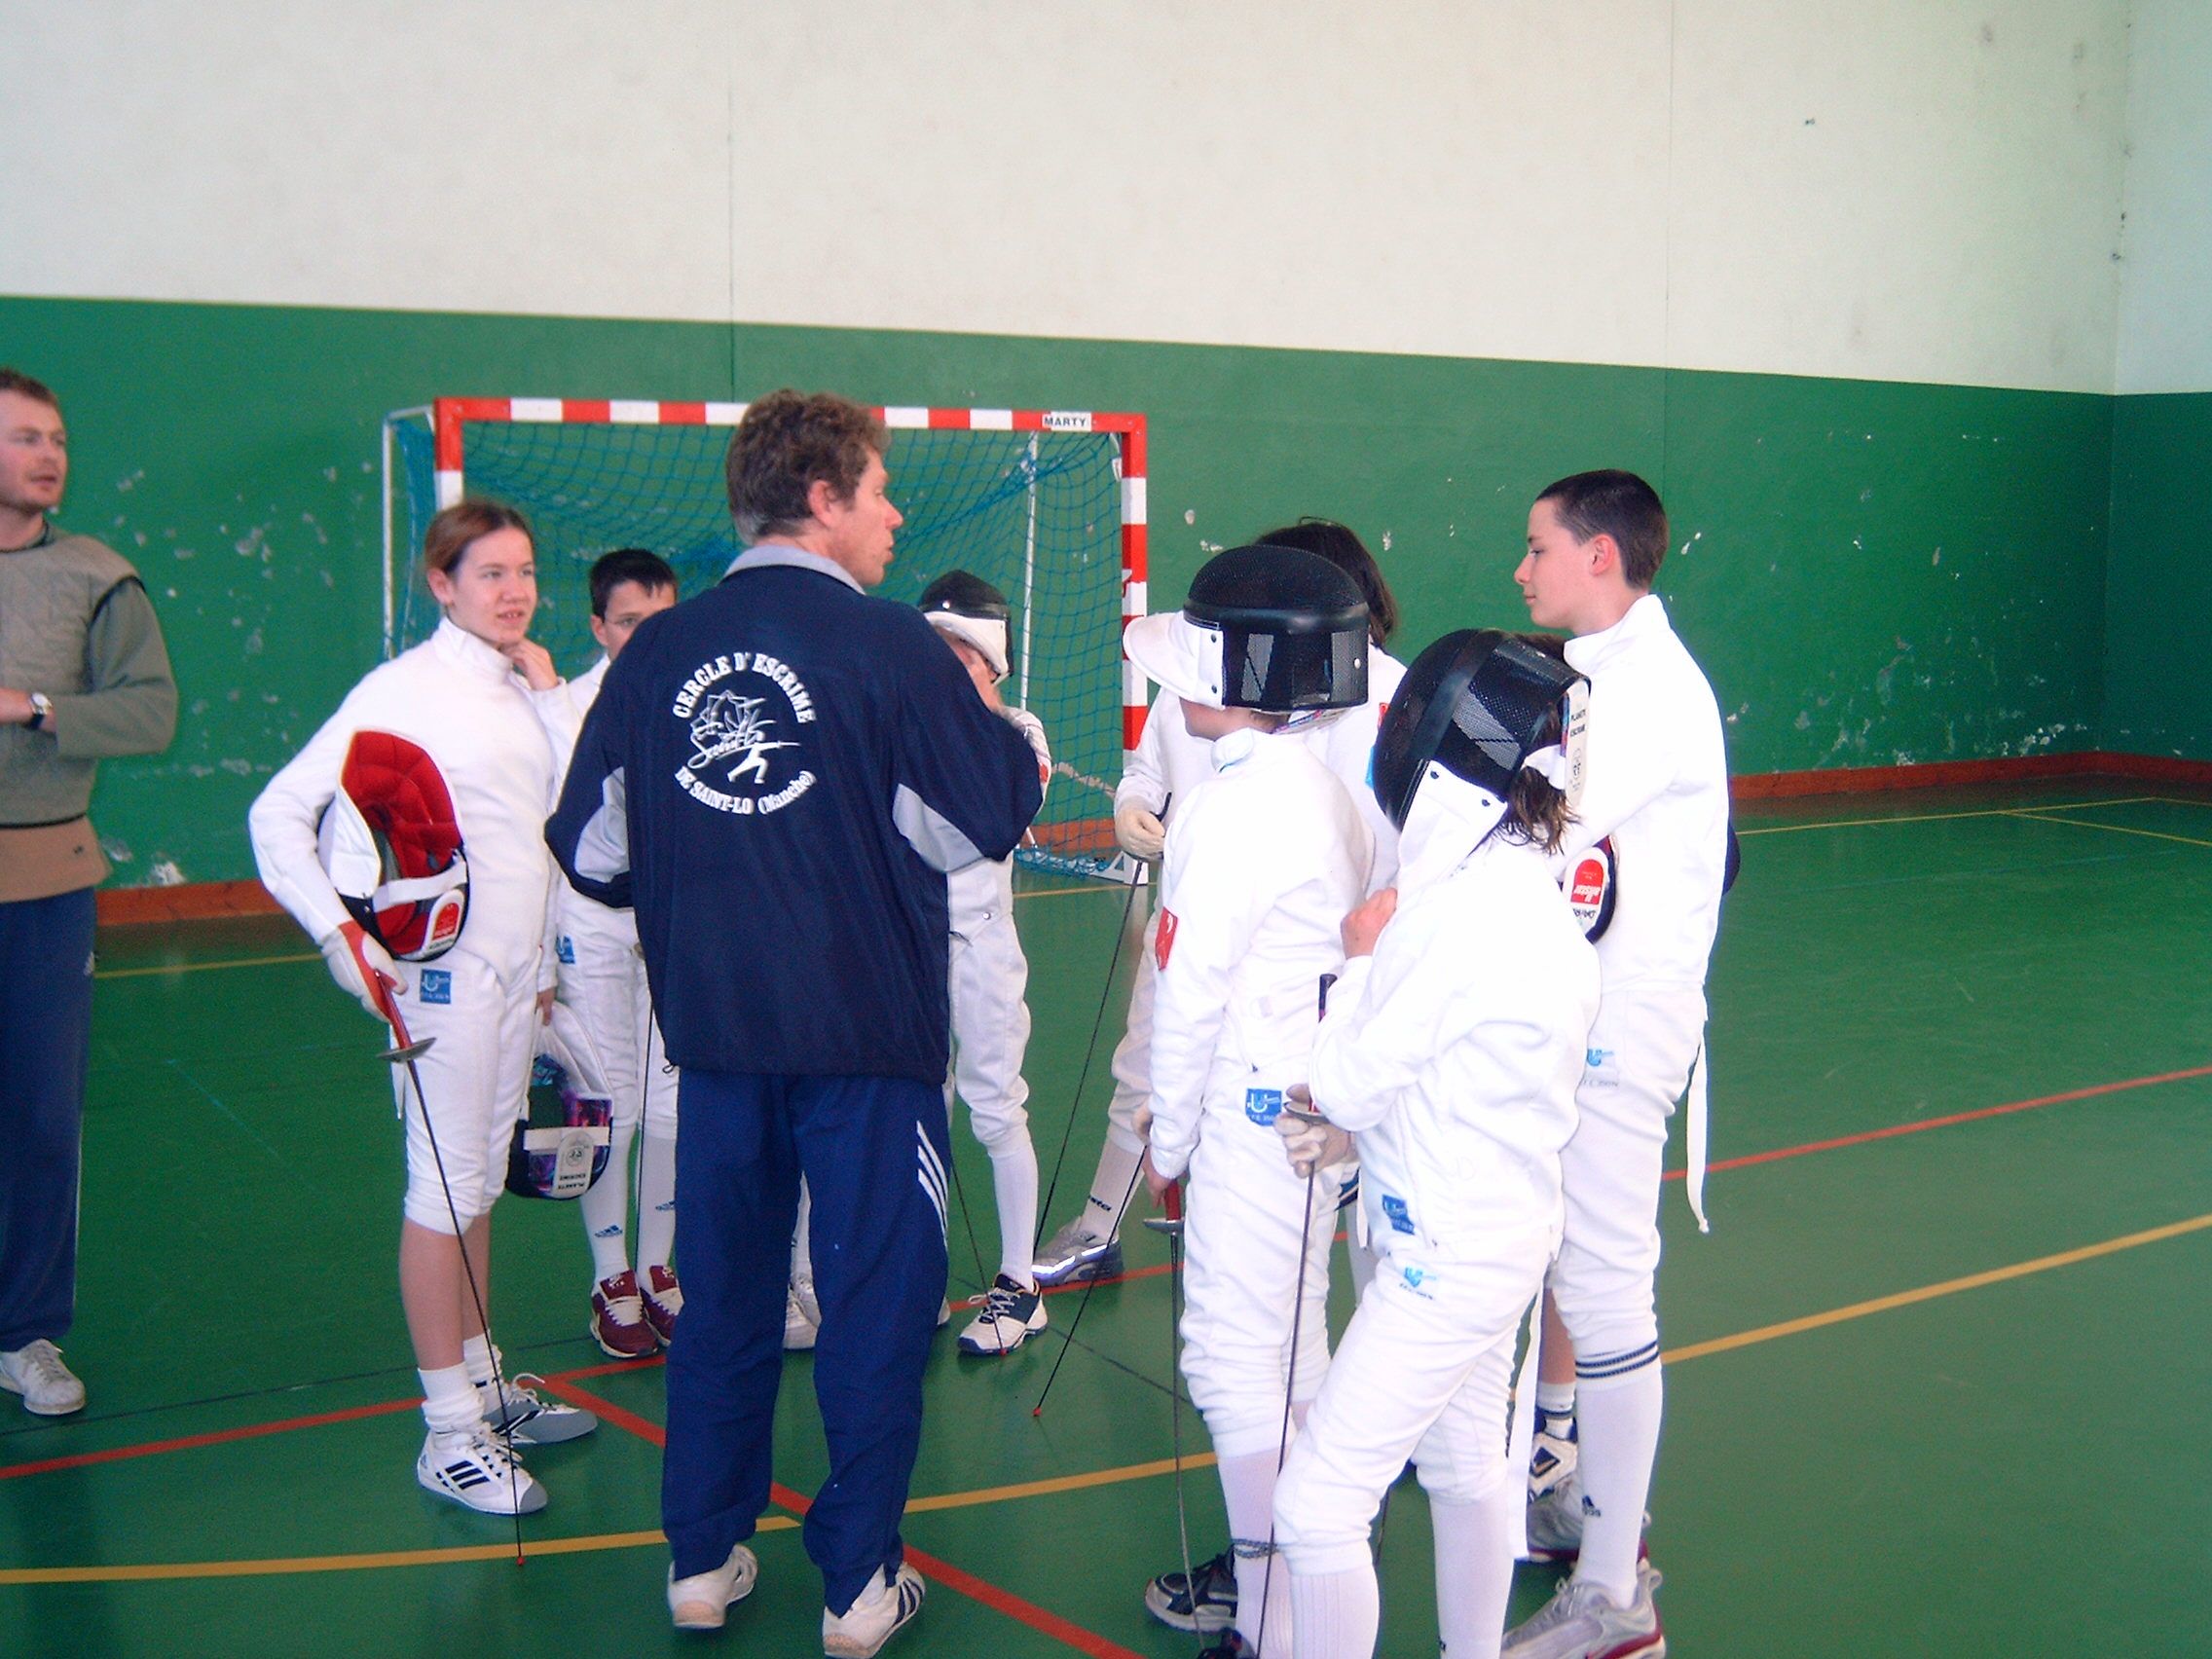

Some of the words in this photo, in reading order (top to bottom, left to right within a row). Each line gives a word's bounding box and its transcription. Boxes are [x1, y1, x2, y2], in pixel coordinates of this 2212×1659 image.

[1044, 417, 1087, 426] MARTY
[672, 655, 732, 719] CERCLE
[752, 652, 818, 723] ESCRIME
[674, 765, 698, 790] DE
[689, 781, 755, 815] SAINT-LO
